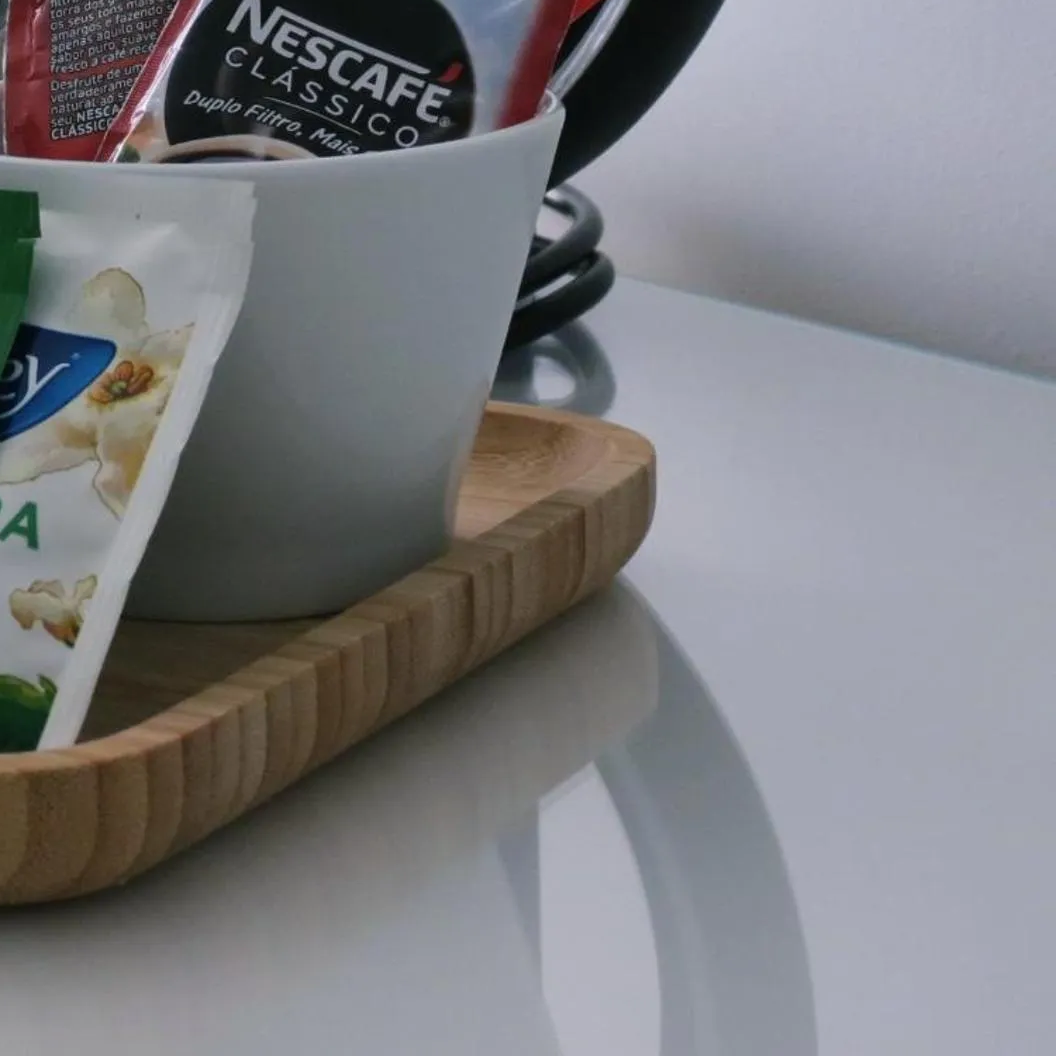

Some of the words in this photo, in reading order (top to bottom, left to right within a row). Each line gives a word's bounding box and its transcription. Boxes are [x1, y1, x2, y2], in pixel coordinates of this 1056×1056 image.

[50, 3, 81, 19] torra
[84, 0, 105, 12] dos
[50, 20, 64, 32] os
[68, 12, 95, 28] seus
[97, 3, 124, 19] tons
[50, 23, 102, 44] amargos
[114, 5, 163, 25] fazendo
[96, 23, 133, 41] aquilo
[135, 18, 159, 34] que
[50, 48, 85, 65] sabor
[121, 31, 158, 47] suave
[50, 60, 89, 75] fresco
[50, 73, 104, 92] Desfrute
[107, 67, 122, 80] de
[50, 77, 134, 104] verdadeirame
[225, 46, 419, 148] CLÁSSICO
[50, 96, 97, 116] natural
[100, 94, 115, 107] ao
[50, 114, 73, 128] seu
[76, 103, 121, 124] NESCA
[183, 90, 242, 115] Duplo
[244, 103, 303, 137] Filtro,
[310, 127, 360, 155] Mais
